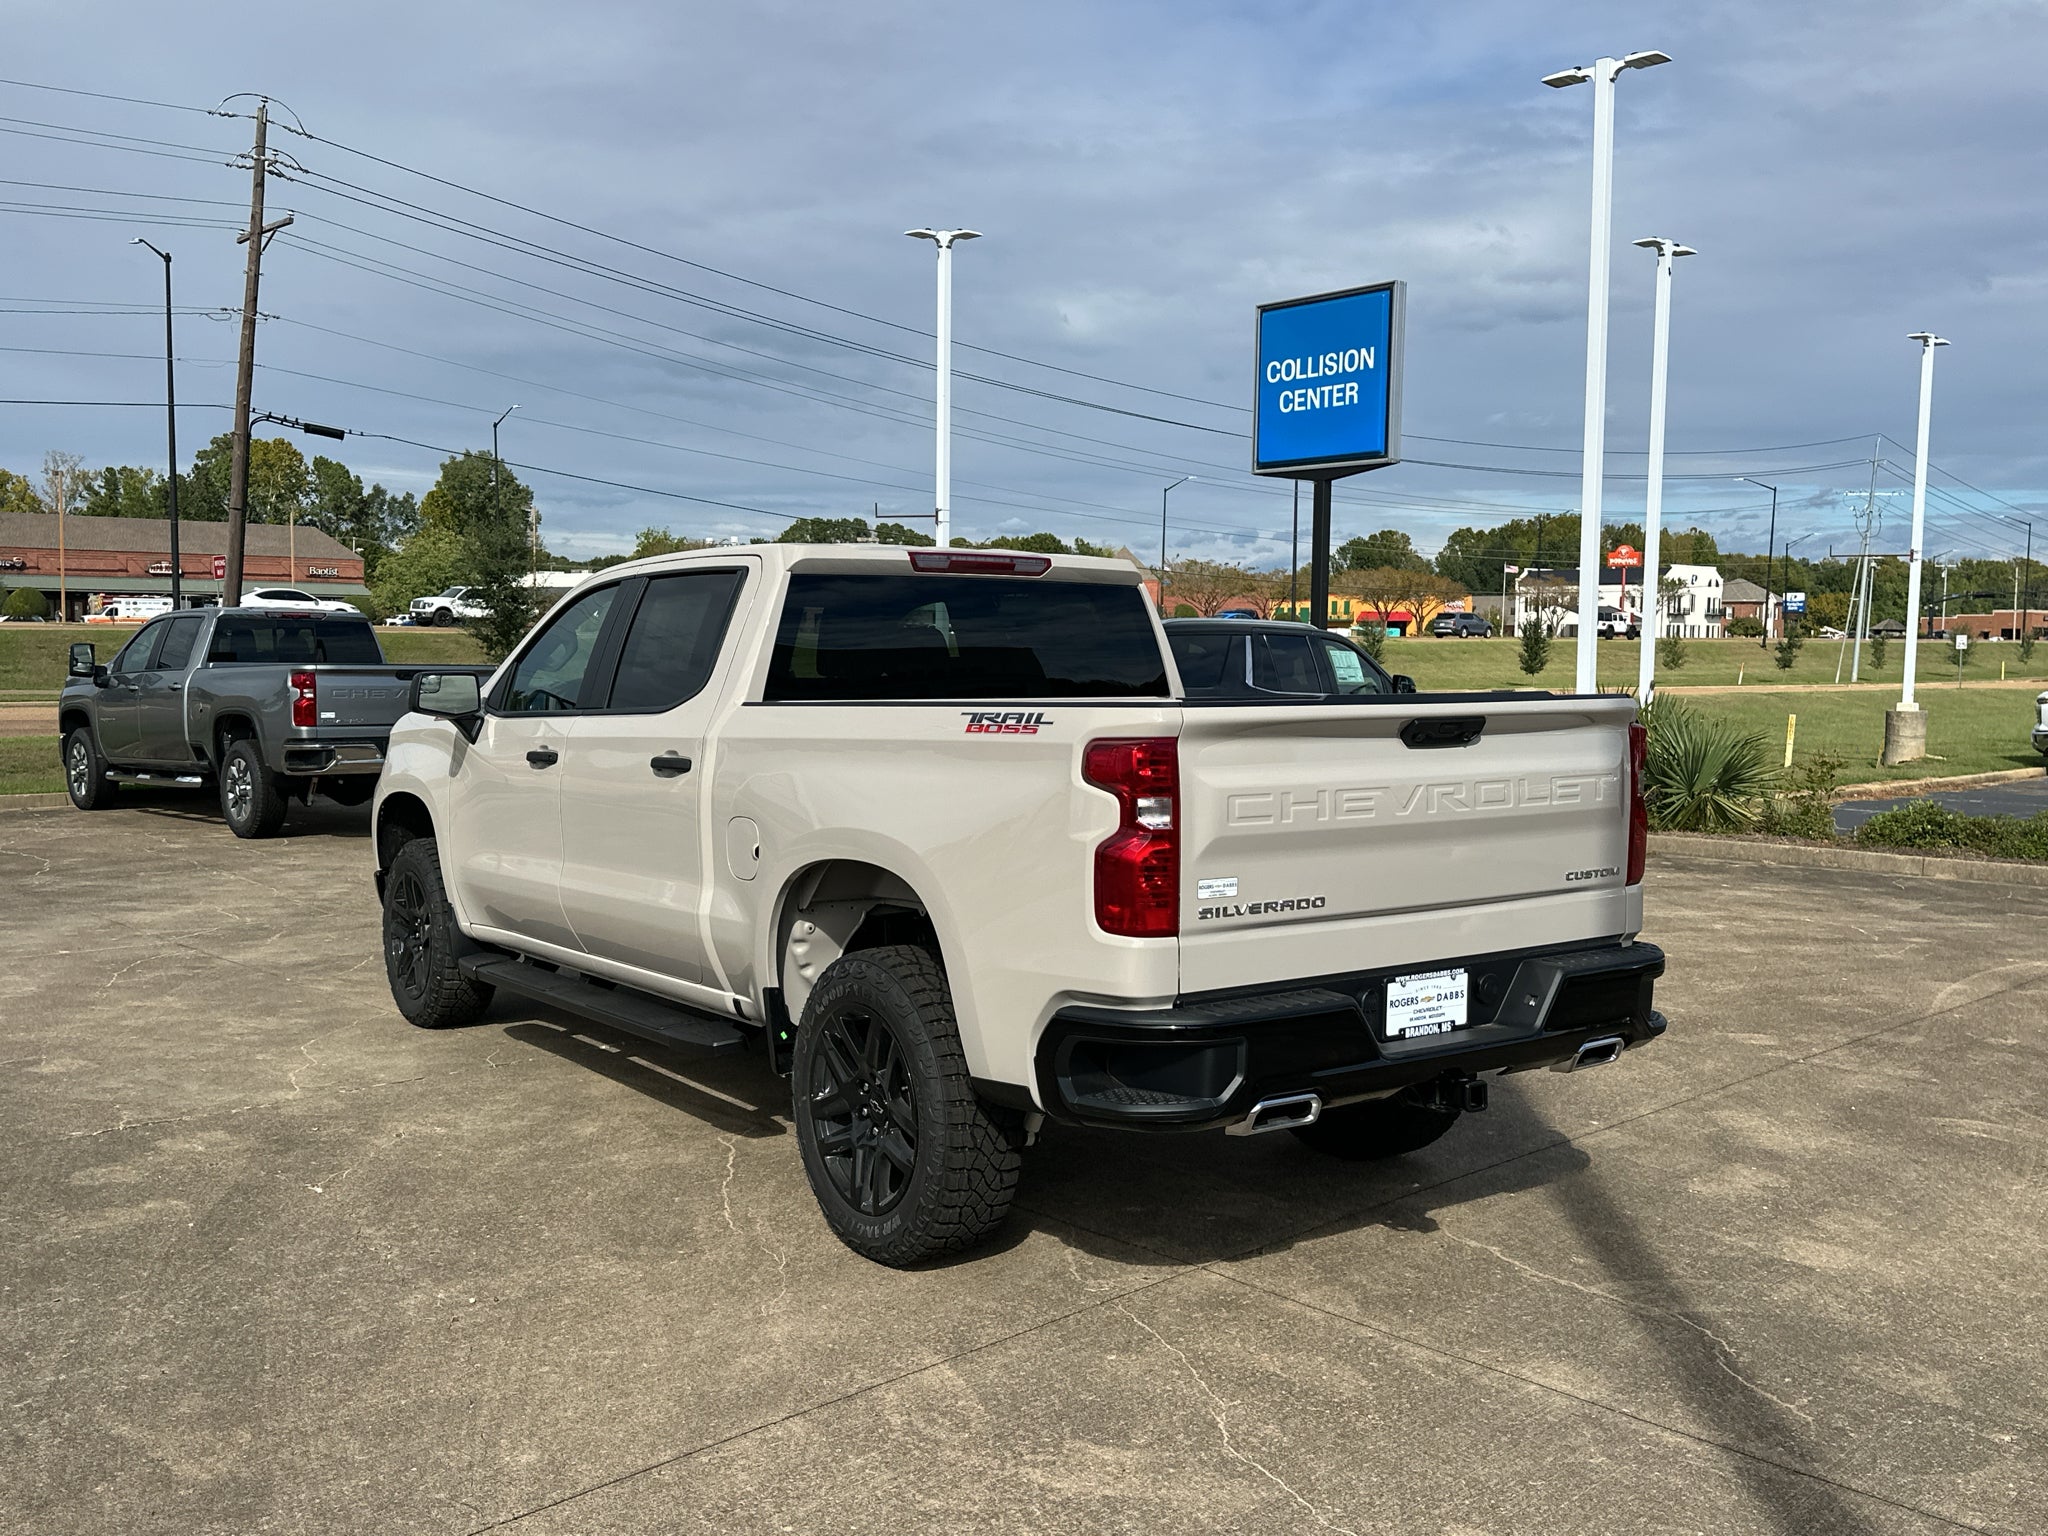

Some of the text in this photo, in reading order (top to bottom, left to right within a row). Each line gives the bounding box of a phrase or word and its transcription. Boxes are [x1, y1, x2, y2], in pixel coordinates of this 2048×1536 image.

[1266, 346, 1375, 384] COLLISION
[1279, 382, 1359, 413] CENTER
[309, 566, 338, 576] Baptist
[960, 711, 1055, 725] TRAIL
[965, 723, 1040, 735] BOSS
[1226, 772, 1619, 827] CHEVROLET
[1565, 866, 1621, 882] CUSTOM
[1197, 896, 1327, 920] SILVERADO
[1395, 968, 1464, 983] WWW.ROGERSDABBS.COM
[1390, 990, 1464, 1008] ROGERS DABBS
[1405, 1022, 1451, 1038] BRANDON, MS
